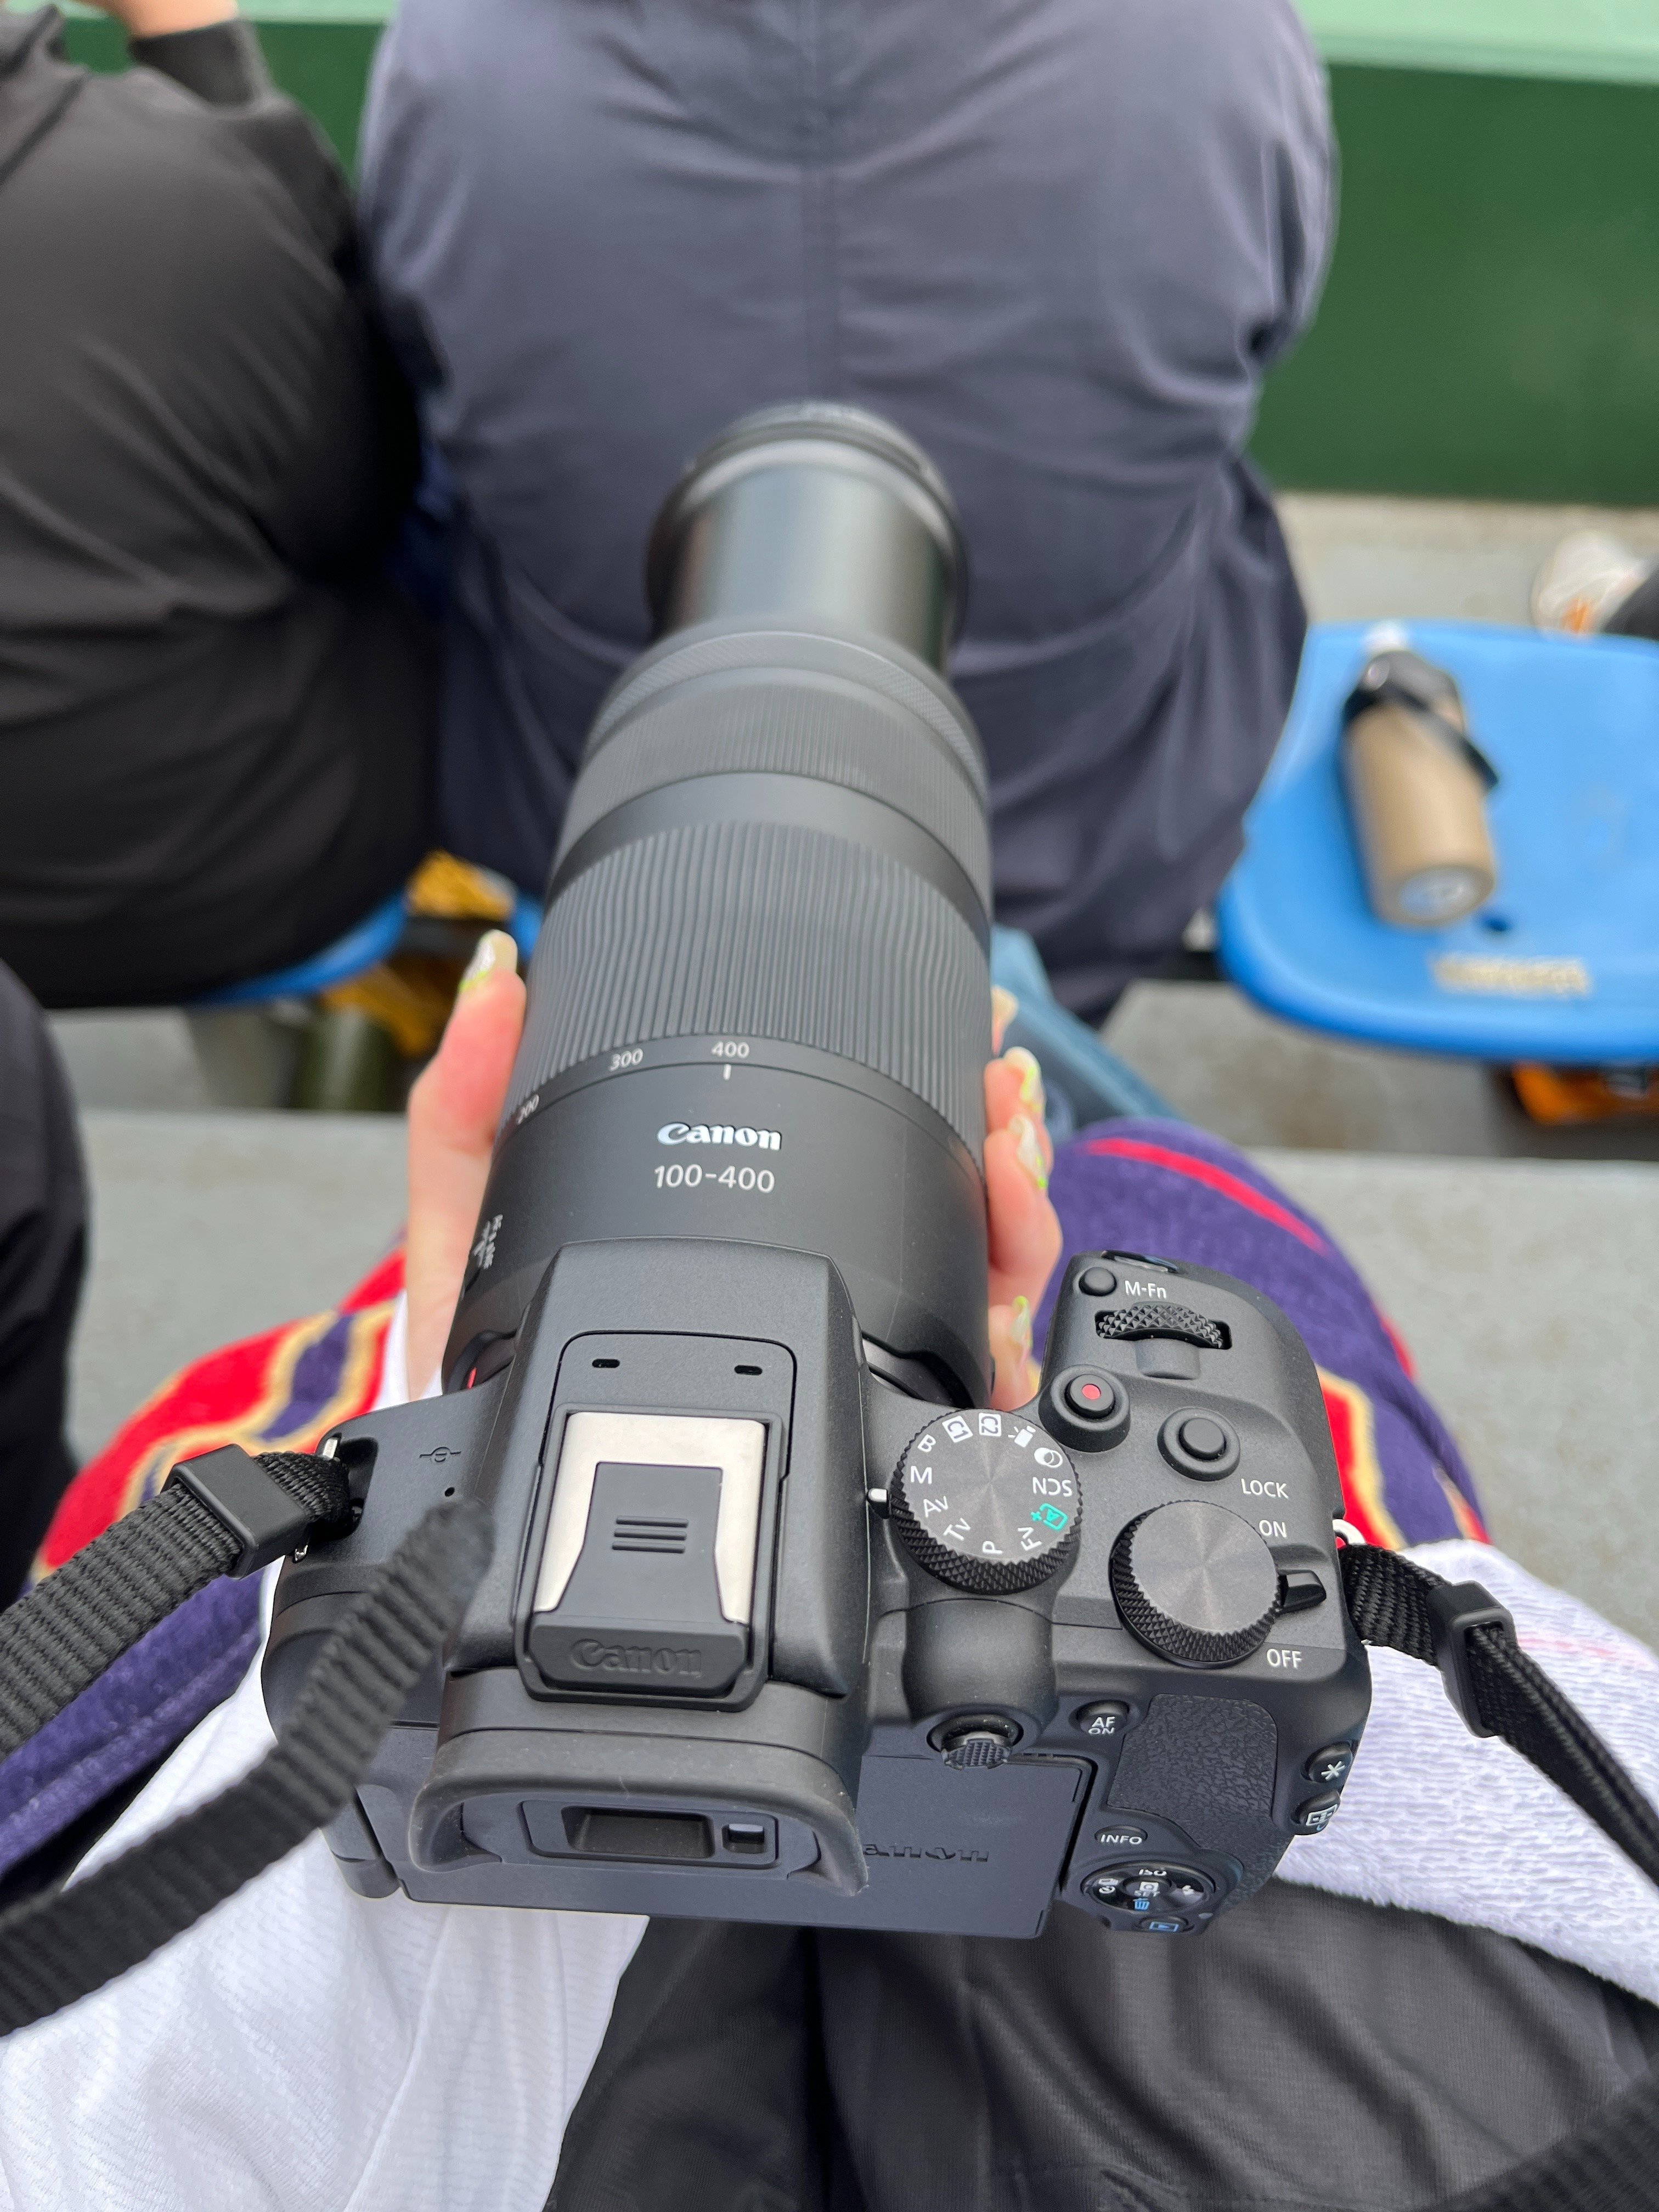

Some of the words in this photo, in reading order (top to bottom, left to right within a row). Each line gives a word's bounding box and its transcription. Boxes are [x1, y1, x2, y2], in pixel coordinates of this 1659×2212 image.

[712, 1042, 749, 1057] 400
[610, 1048, 644, 1071] 300
[657, 1122, 781, 1151] Canon
[655, 1165, 774, 1193] 100-400
[1125, 1280, 1167, 1299] M-Fn
[981, 1415, 999, 1435] C2
[917, 1435, 936, 1453] B
[911, 1466, 932, 1485] M
[1032, 1477, 1072, 1497] SCN
[1242, 1479, 1288, 1499] LOCK
[923, 1496, 948, 1517] Av
[944, 1518, 970, 1541] Tv
[1259, 1520, 1286, 1538] ON
[983, 1541, 1003, 1554] P
[571, 1638, 702, 1678] Canon
[1267, 1649, 1302, 1668] OFF
[1092, 1716, 1115, 1728] AF
[1101, 1835, 1142, 1844] INFO
[861, 1843, 989, 1862] anon
